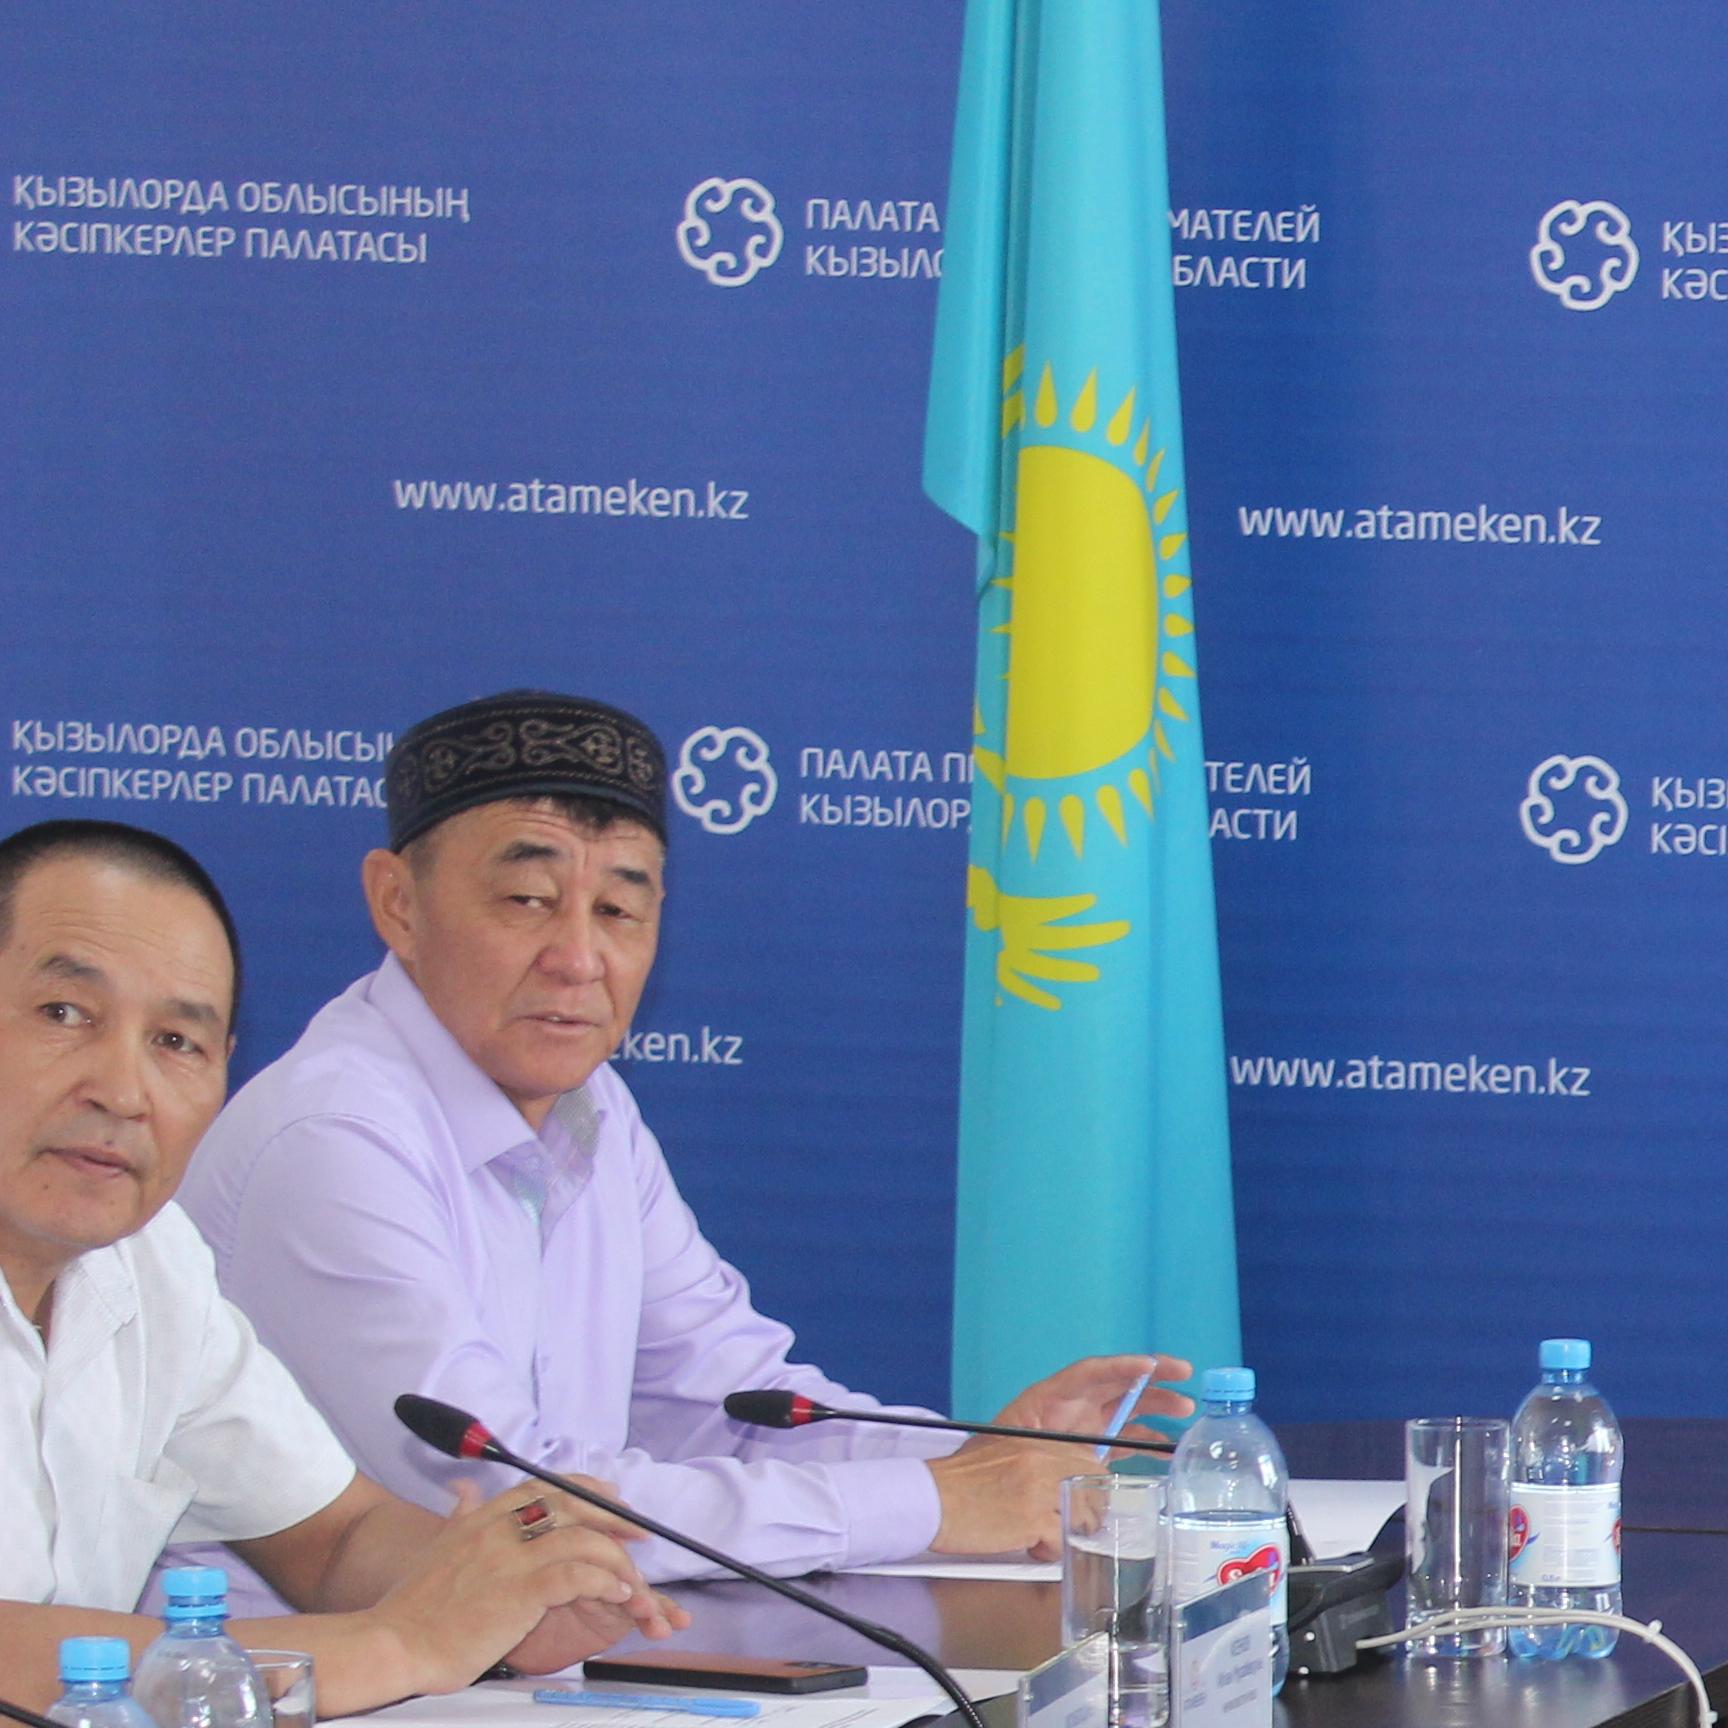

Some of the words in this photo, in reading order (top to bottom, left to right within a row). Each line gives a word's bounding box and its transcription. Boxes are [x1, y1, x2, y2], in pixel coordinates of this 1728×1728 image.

[11, 174, 229, 214] ҚЫЗЫЛОРДА
[237, 182, 470, 222] ОБЛЫСЫНЫҢ
[804, 197, 941, 233] ПАЛАТА
[12, 220, 236, 257] КӘСІПКЕРЛЕР
[243, 227, 427, 263] ПАЛАТАСЫ
[1172, 255, 1306, 290] БЛАСТИ
[391, 478, 749, 520] www.atameken.kz
[1237, 503, 1601, 545] www.atameken.kz
[10, 719, 226, 759] ҚЫЗЫЛОРДА
[233, 727, 394, 762] ОБЛЫСЫ
[799, 746, 933, 782] ПАЛАТА
[11, 765, 233, 802] КӘСІПКЕРЛЕР
[241, 773, 388, 809] ПАЛАТА
[798, 793, 973, 833] КЫЗЫЛОР
[1208, 808, 1298, 841] АСТИ
[1230, 1054, 1591, 1097] www.atameken.kz
